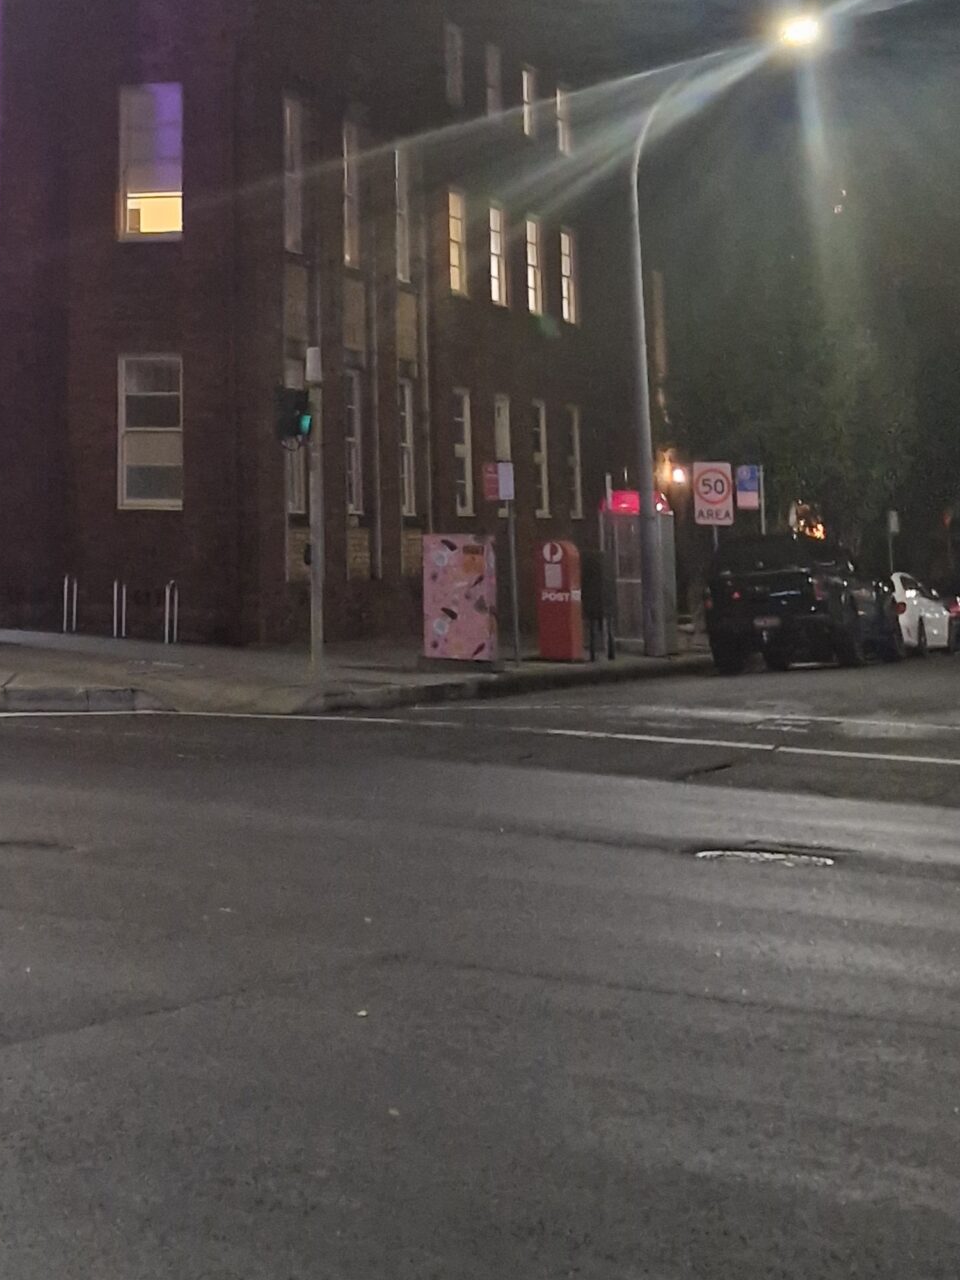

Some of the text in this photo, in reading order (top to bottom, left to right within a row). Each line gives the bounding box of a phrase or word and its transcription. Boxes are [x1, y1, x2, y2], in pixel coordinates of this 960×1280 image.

[701, 478, 725, 495] 50
[697, 509, 732, 521] AREA
[541, 591, 570, 602] POST
